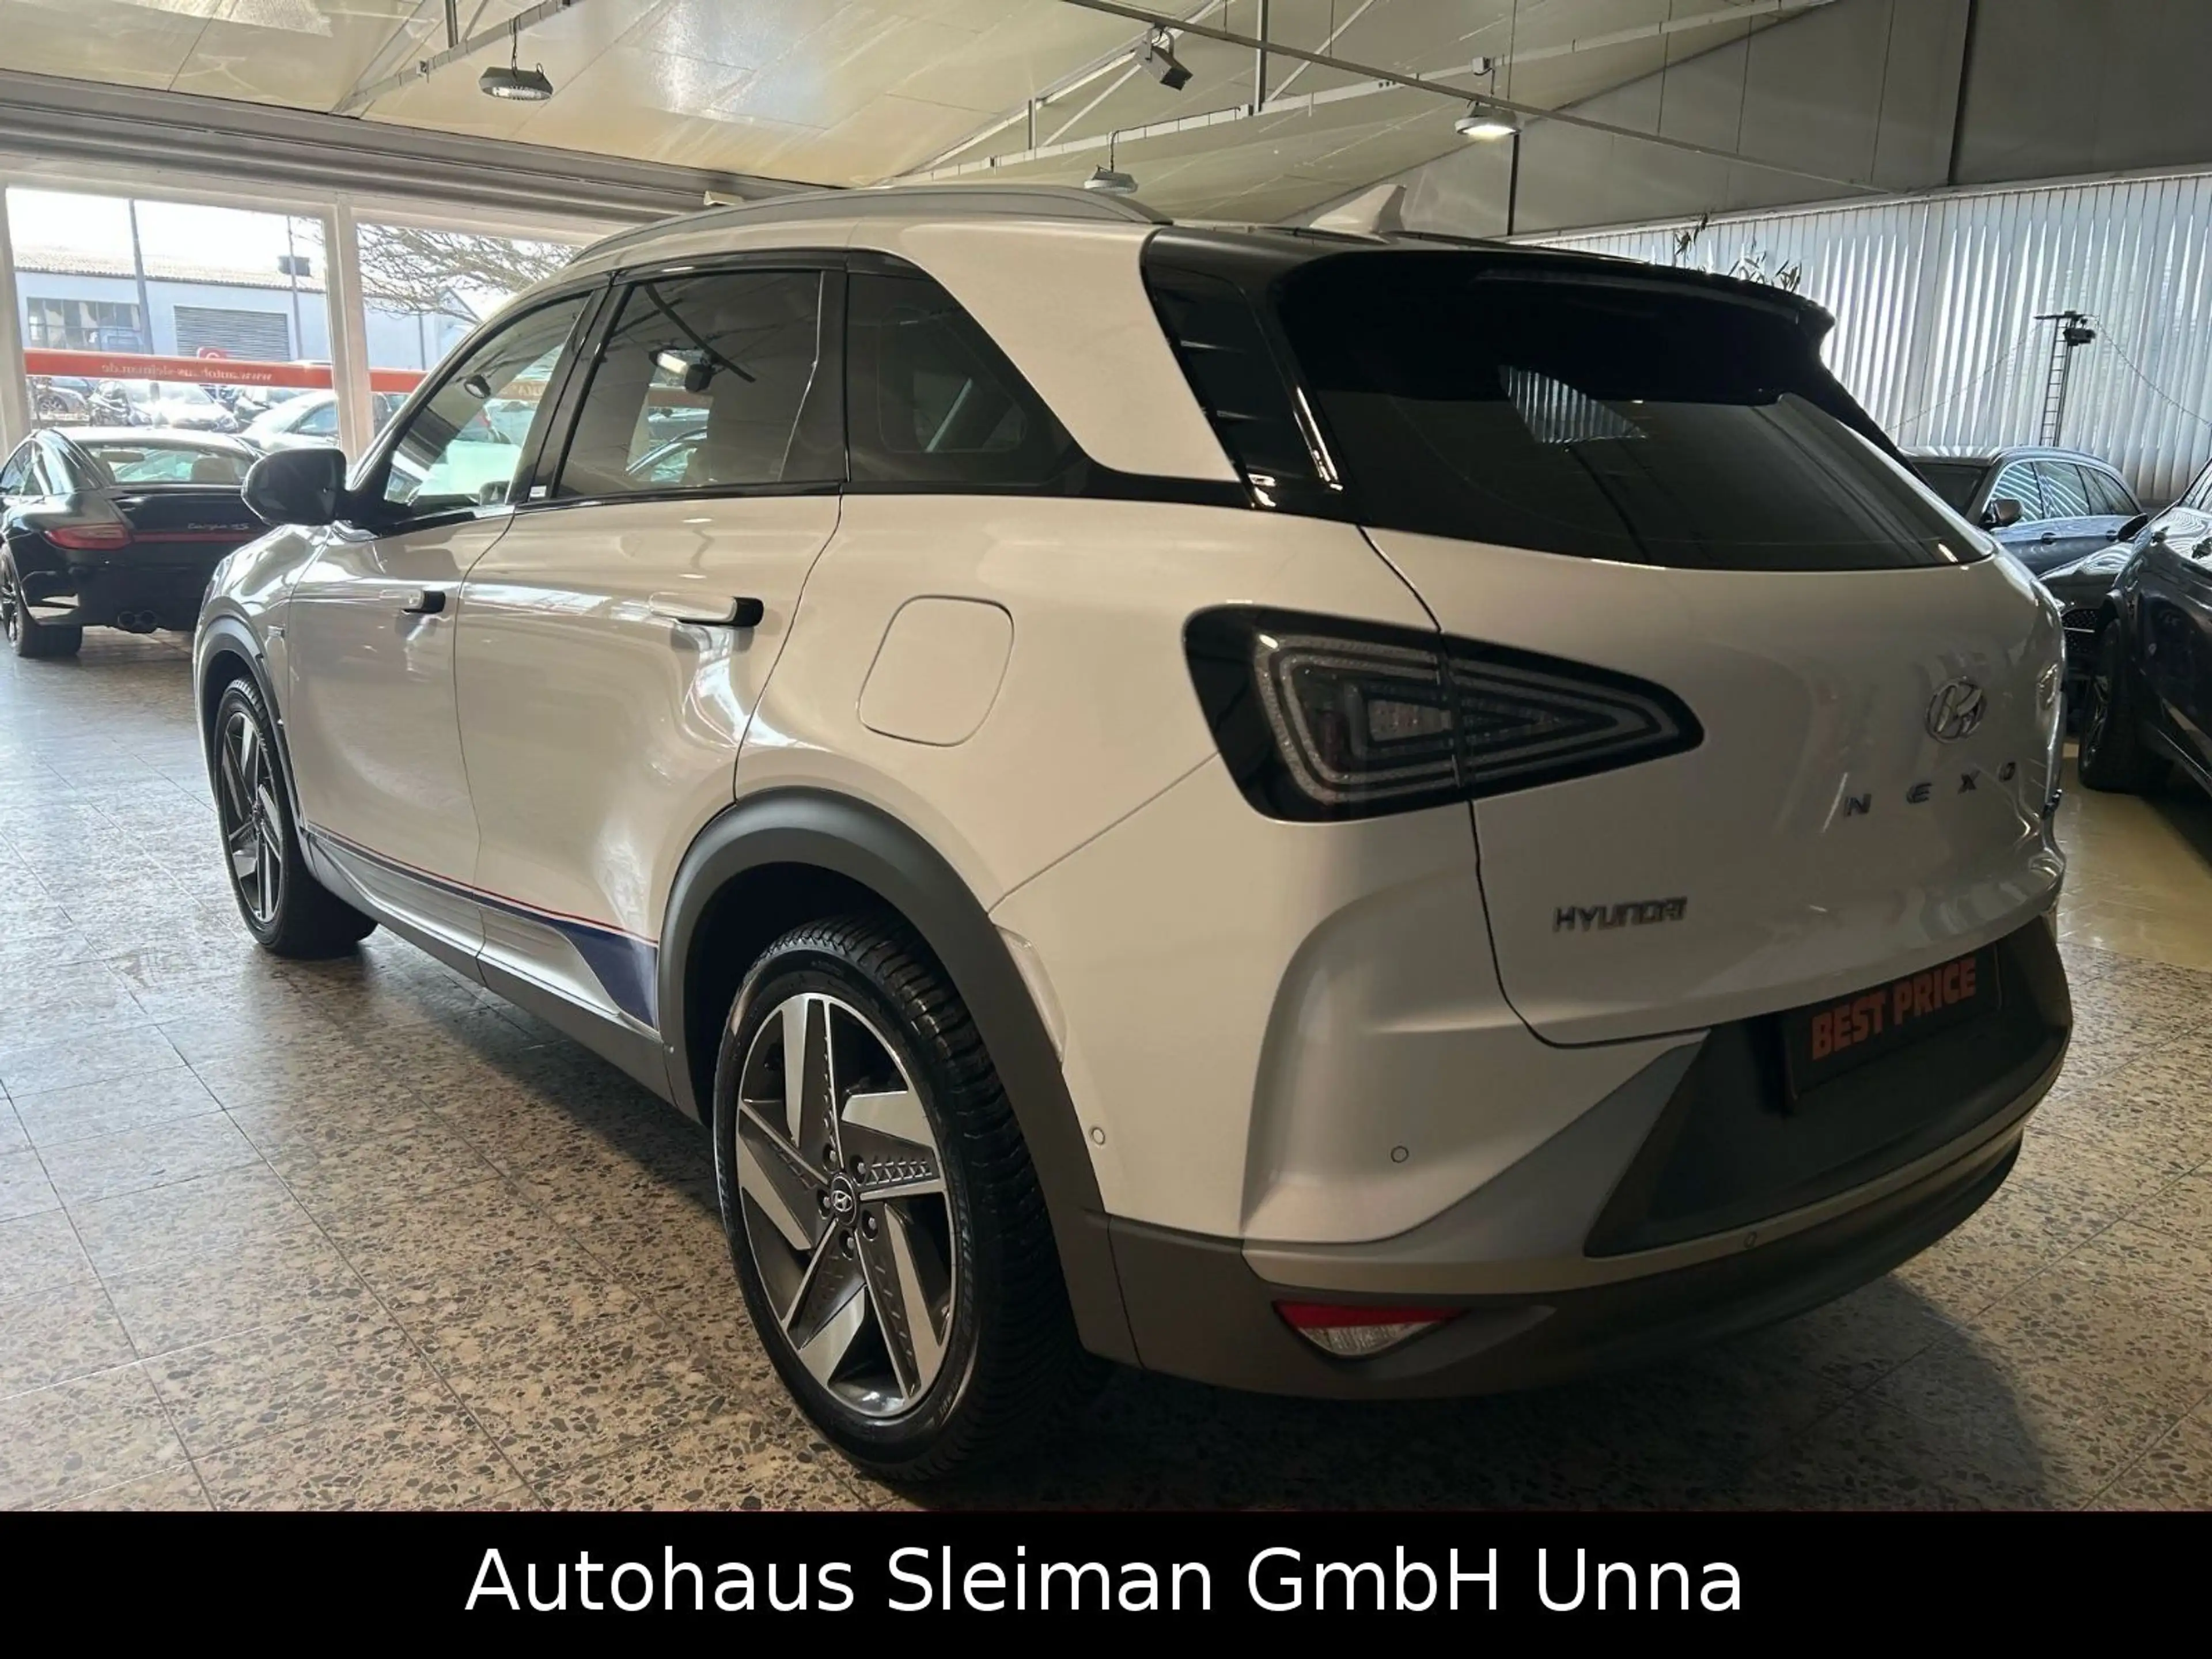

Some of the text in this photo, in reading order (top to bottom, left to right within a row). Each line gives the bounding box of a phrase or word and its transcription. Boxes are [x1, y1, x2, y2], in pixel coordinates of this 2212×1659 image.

[1552, 896, 1688, 933] HYUNDAI
[1812, 957, 1976, 1060] BEST PRICE
